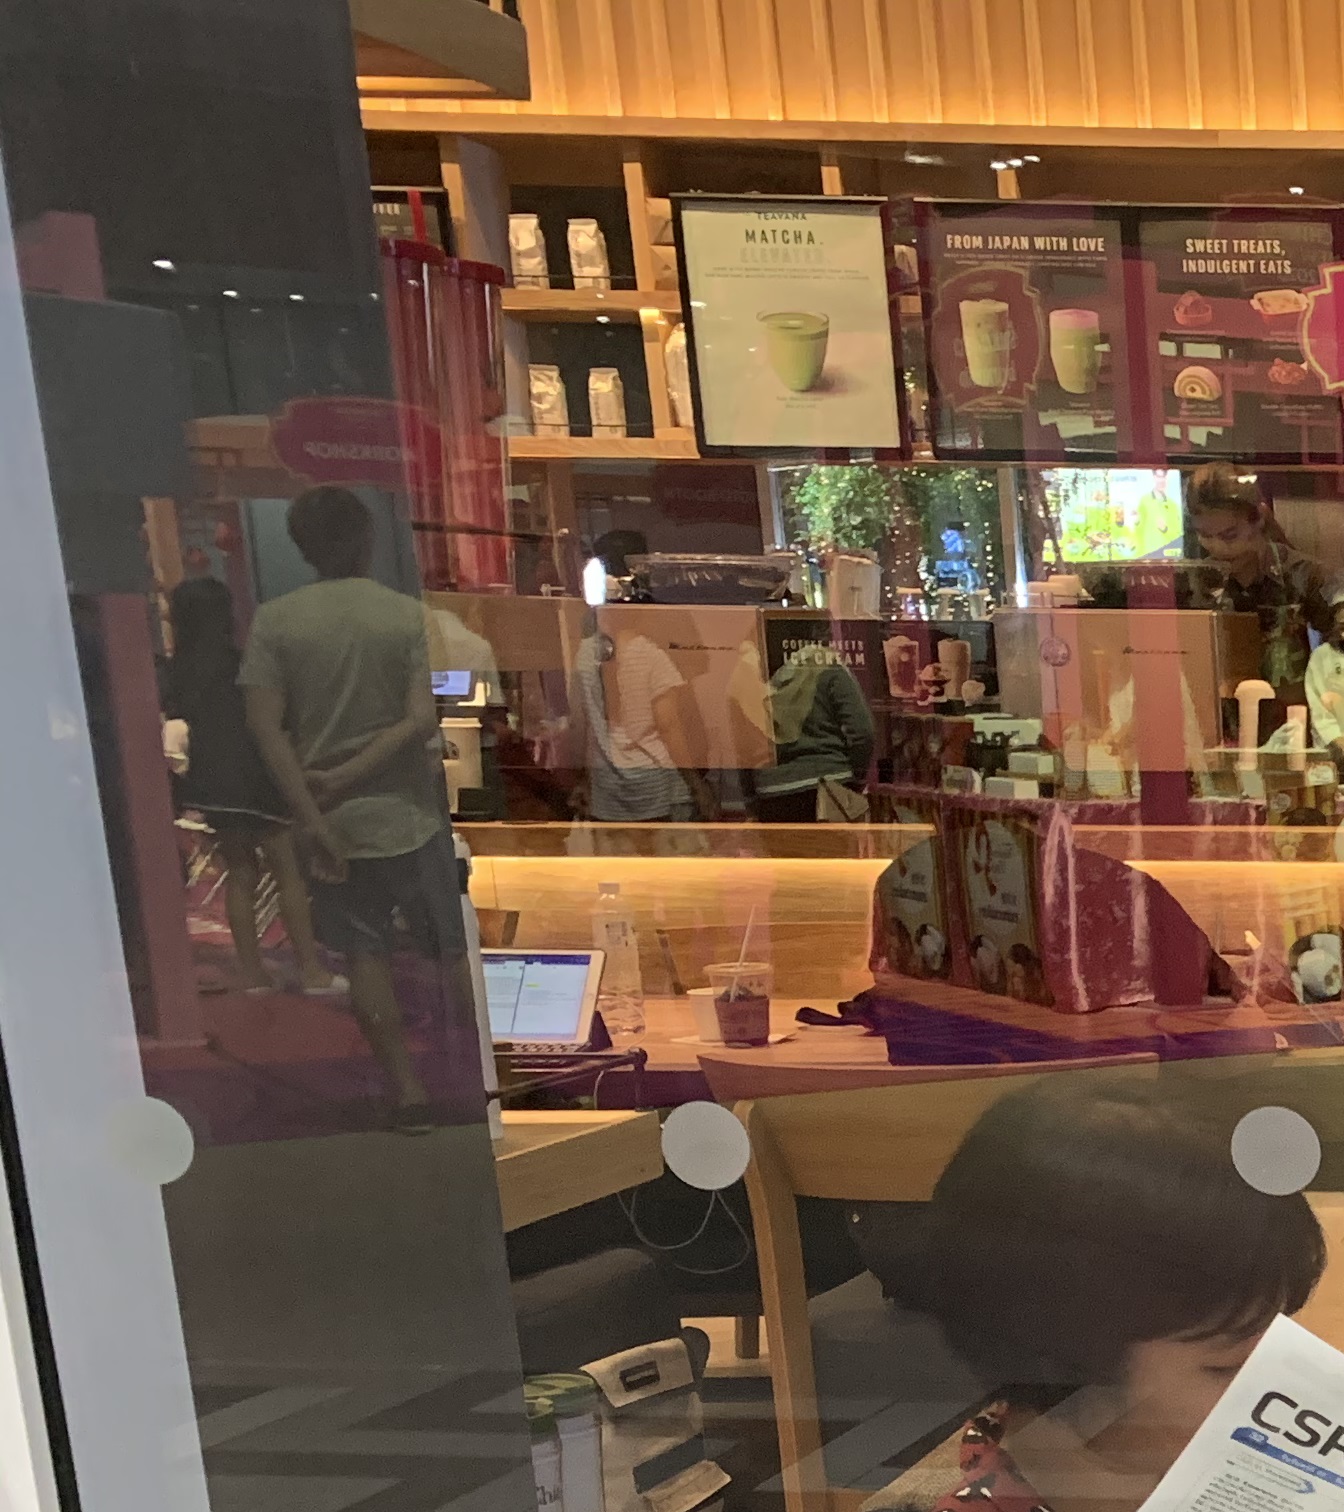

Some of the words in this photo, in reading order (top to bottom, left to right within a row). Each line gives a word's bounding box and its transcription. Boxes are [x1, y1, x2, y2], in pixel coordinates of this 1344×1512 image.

[946, 234, 983, 250] FROM
[988, 235, 1029, 250] JAPAN
[1034, 236, 1068, 251] WITH
[1072, 237, 1105, 252] LOVE
[1185, 238, 1229, 254] SWEET
[1232, 239, 1286, 256] TREATS,
[1182, 259, 1256, 274] INDULGENT
[1260, 259, 1292, 275] EATS
[782, 639, 822, 650] COFFEE
[783, 651, 807, 665] ICE
[814, 652, 865, 665] CREAM
